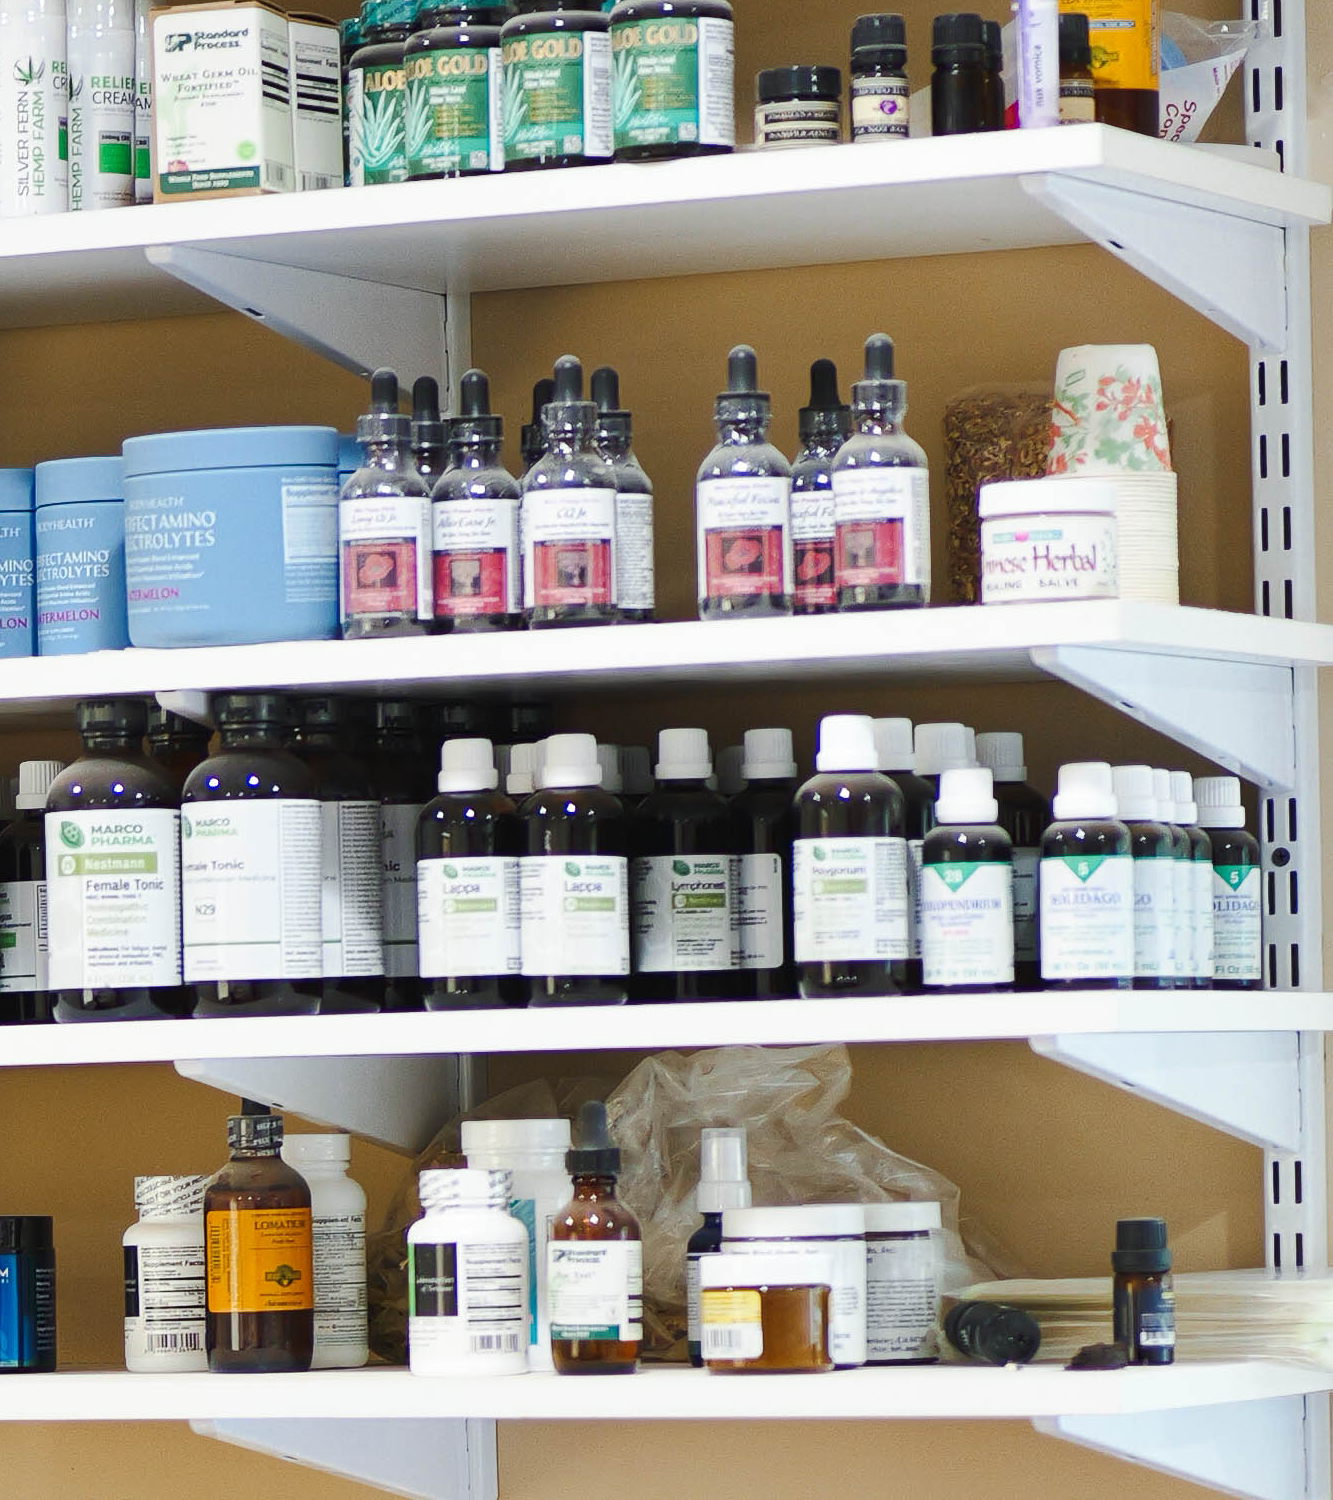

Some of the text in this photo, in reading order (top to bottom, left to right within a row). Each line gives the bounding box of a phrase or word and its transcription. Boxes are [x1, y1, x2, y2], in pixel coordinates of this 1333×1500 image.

[194, 28, 249, 42] Standard
[647, 24, 698, 46] GOLD
[194, 39, 241, 51] Process
[531, 36, 583, 60] GOLD
[436, 55, 487, 77] GOLD
[16, 91, 29, 196] SILVER FERN
[32, 90, 44, 196] HEMP FARM
[91, 824, 143, 834] MARCO
[91, 835, 154, 846] PHARMA
[84, 857, 145, 869] Nestmann
[85, 878, 164, 892] Female Tonic
